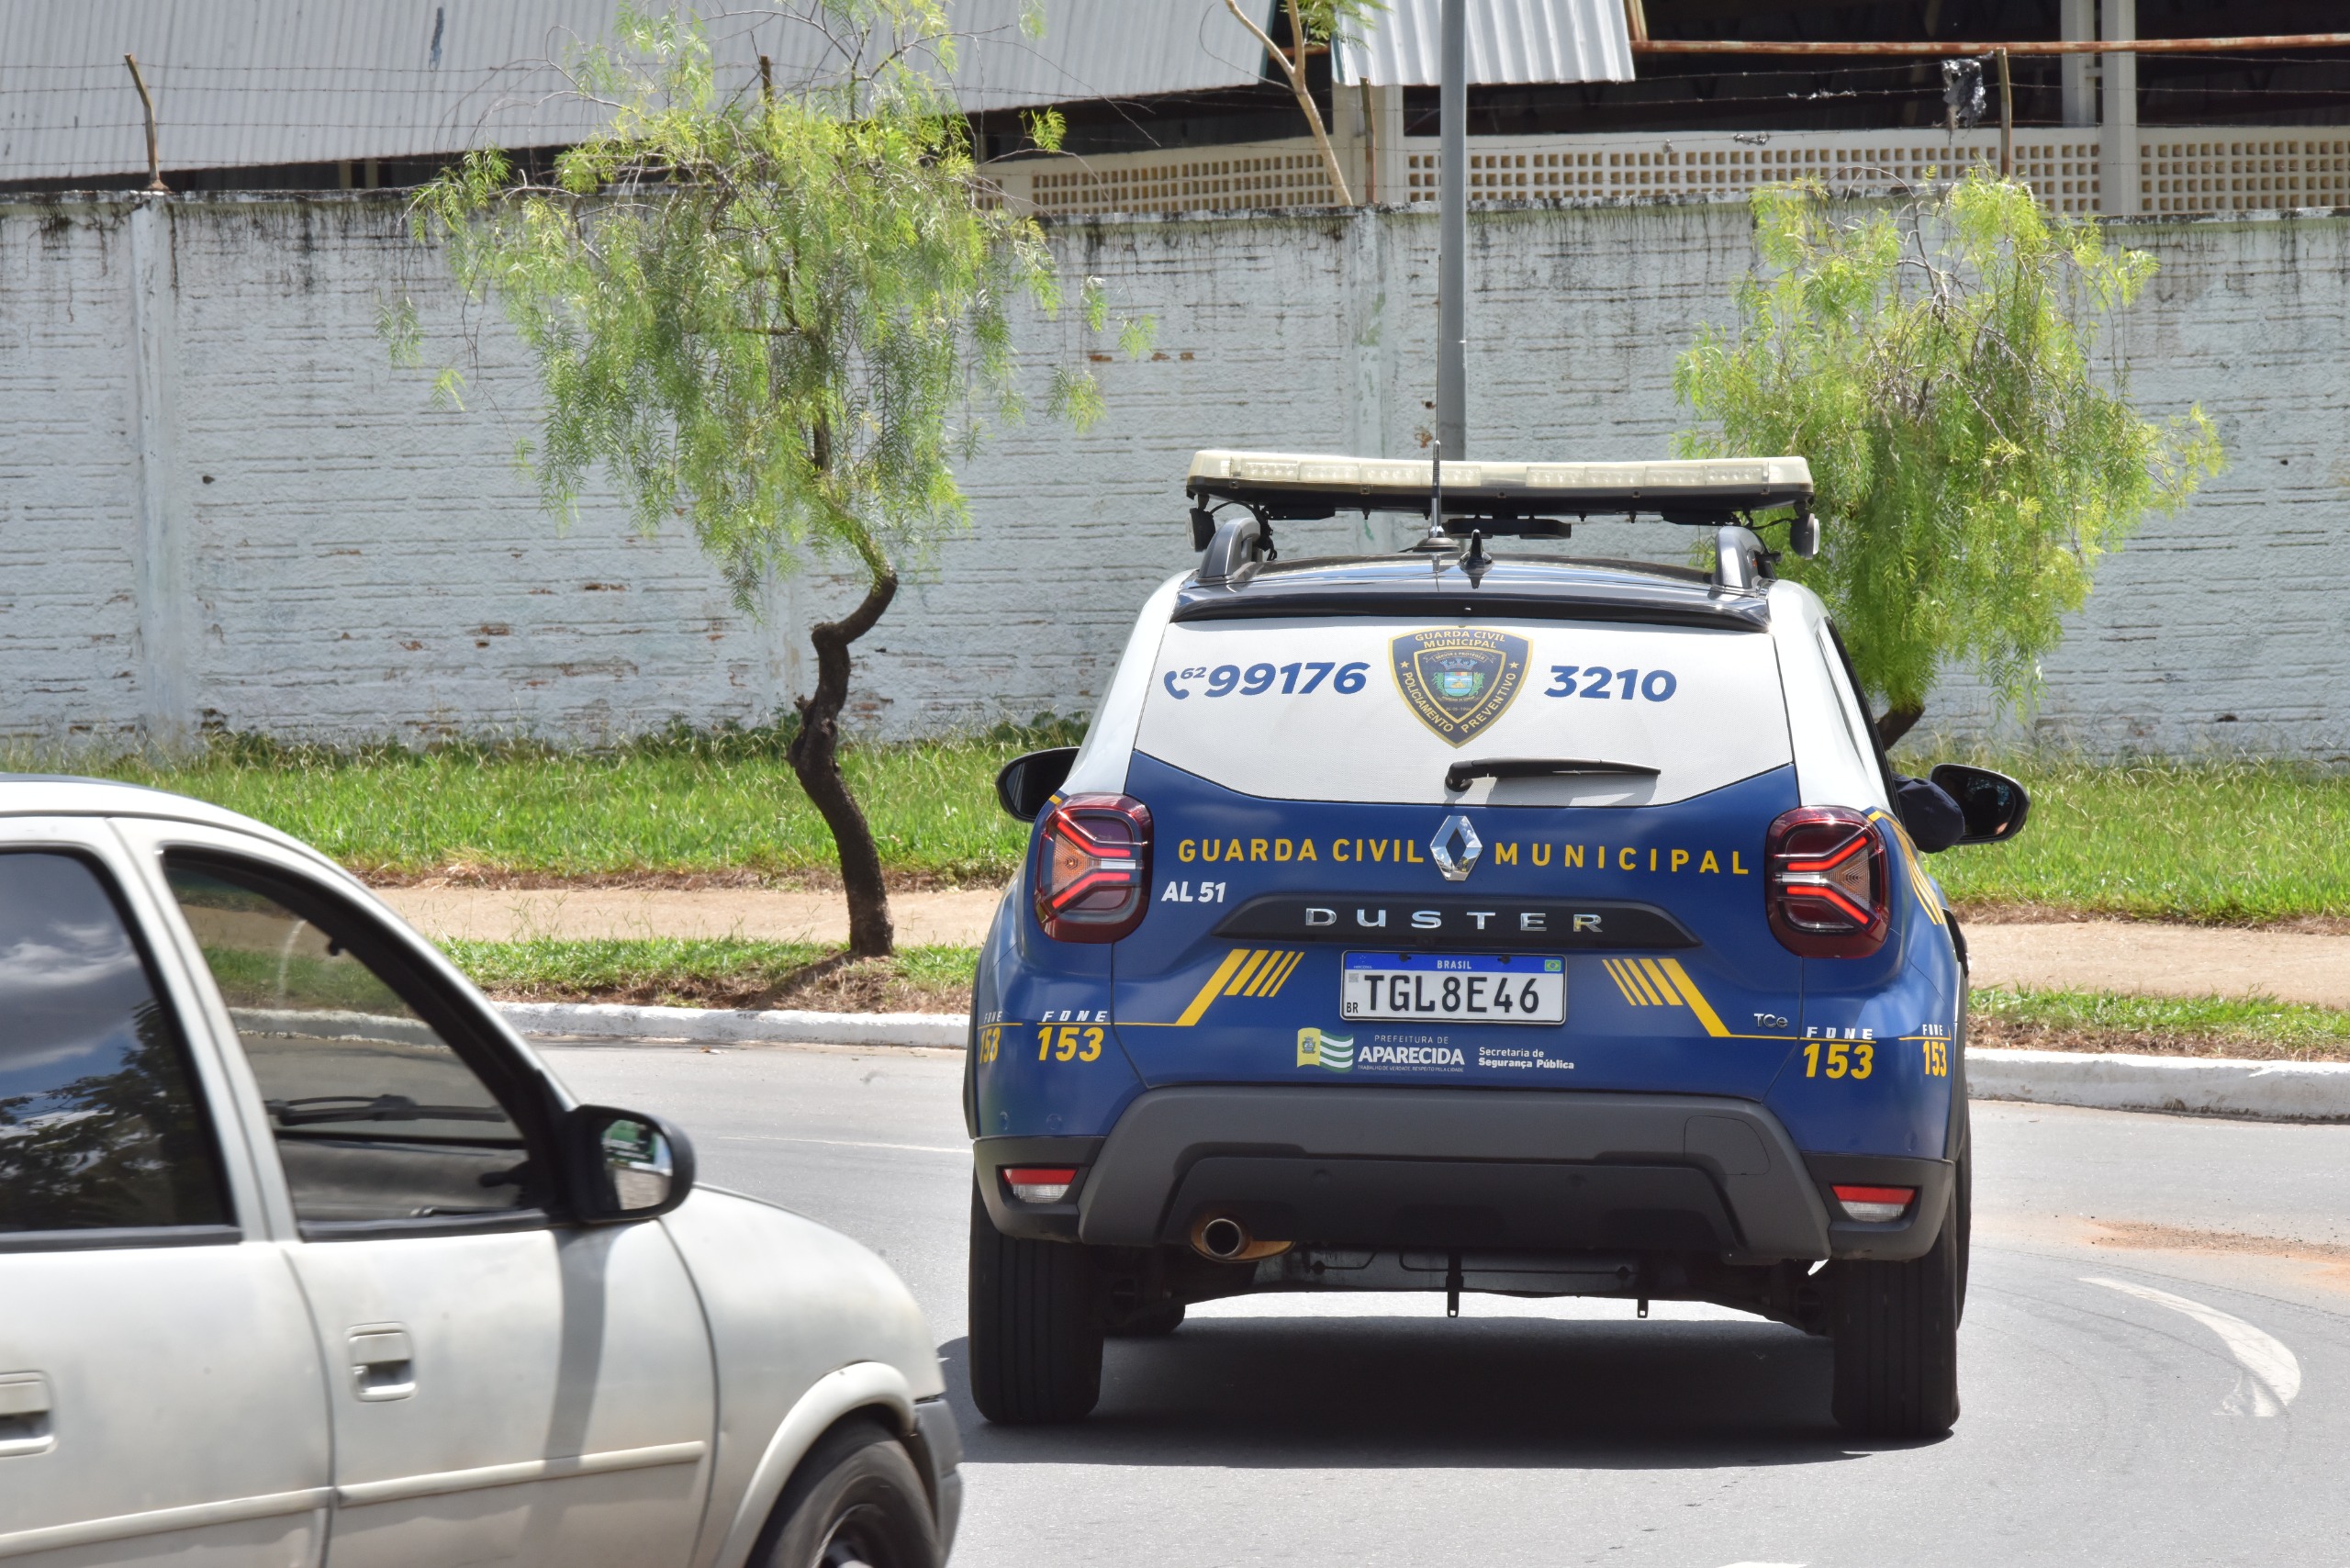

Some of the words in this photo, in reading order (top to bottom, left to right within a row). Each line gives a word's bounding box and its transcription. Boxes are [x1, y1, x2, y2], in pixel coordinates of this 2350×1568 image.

[1415, 631, 1470, 641] GUARDA
[1473, 631, 1505, 642] CIVIL
[1424, 638, 1496, 648] MUNICIPAL
[1180, 666, 1207, 679] 62
[1203, 662, 1371, 698] 99176
[1544, 665, 1677, 702] 3210
[1403, 671, 1454, 733] POLICIAMENTO
[1460, 672, 1516, 734] PREVENTIVO
[1178, 838, 1318, 862] GUARDA
[1332, 838, 1425, 863] CIVIL
[1494, 842, 1749, 874] MUNICIPAL
[1160, 881, 1193, 902] AL
[1198, 881, 1226, 902] 51
[1305, 907, 1604, 933] DUSTER
[1437, 959, 1472, 969] BRASIL
[1364, 974, 1540, 1014] TGL8E46
[1041, 1010, 1108, 1023] FONE
[1346, 1002, 1359, 1014] BR
[983, 1011, 1003, 1025] FONE
[1753, 1013, 1789, 1029] TCe
[1806, 1026, 1874, 1040] FONE
[1922, 1024, 1943, 1036] FONE
[979, 1026, 1002, 1065] 153
[1037, 1026, 1104, 1062] 153
[1374, 1035, 1434, 1044] PREFEITURA
[1437, 1036, 1449, 1045] DE
[1358, 1046, 1466, 1066] APARECIDA
[1479, 1047, 1530, 1058] Secretaria
[1532, 1048, 1545, 1058] de
[1803, 1043, 1874, 1080] 153
[1922, 1040, 1947, 1078] 153
[1478, 1057, 1533, 1070] Segurança
[1536, 1058, 1575, 1070] Pública
